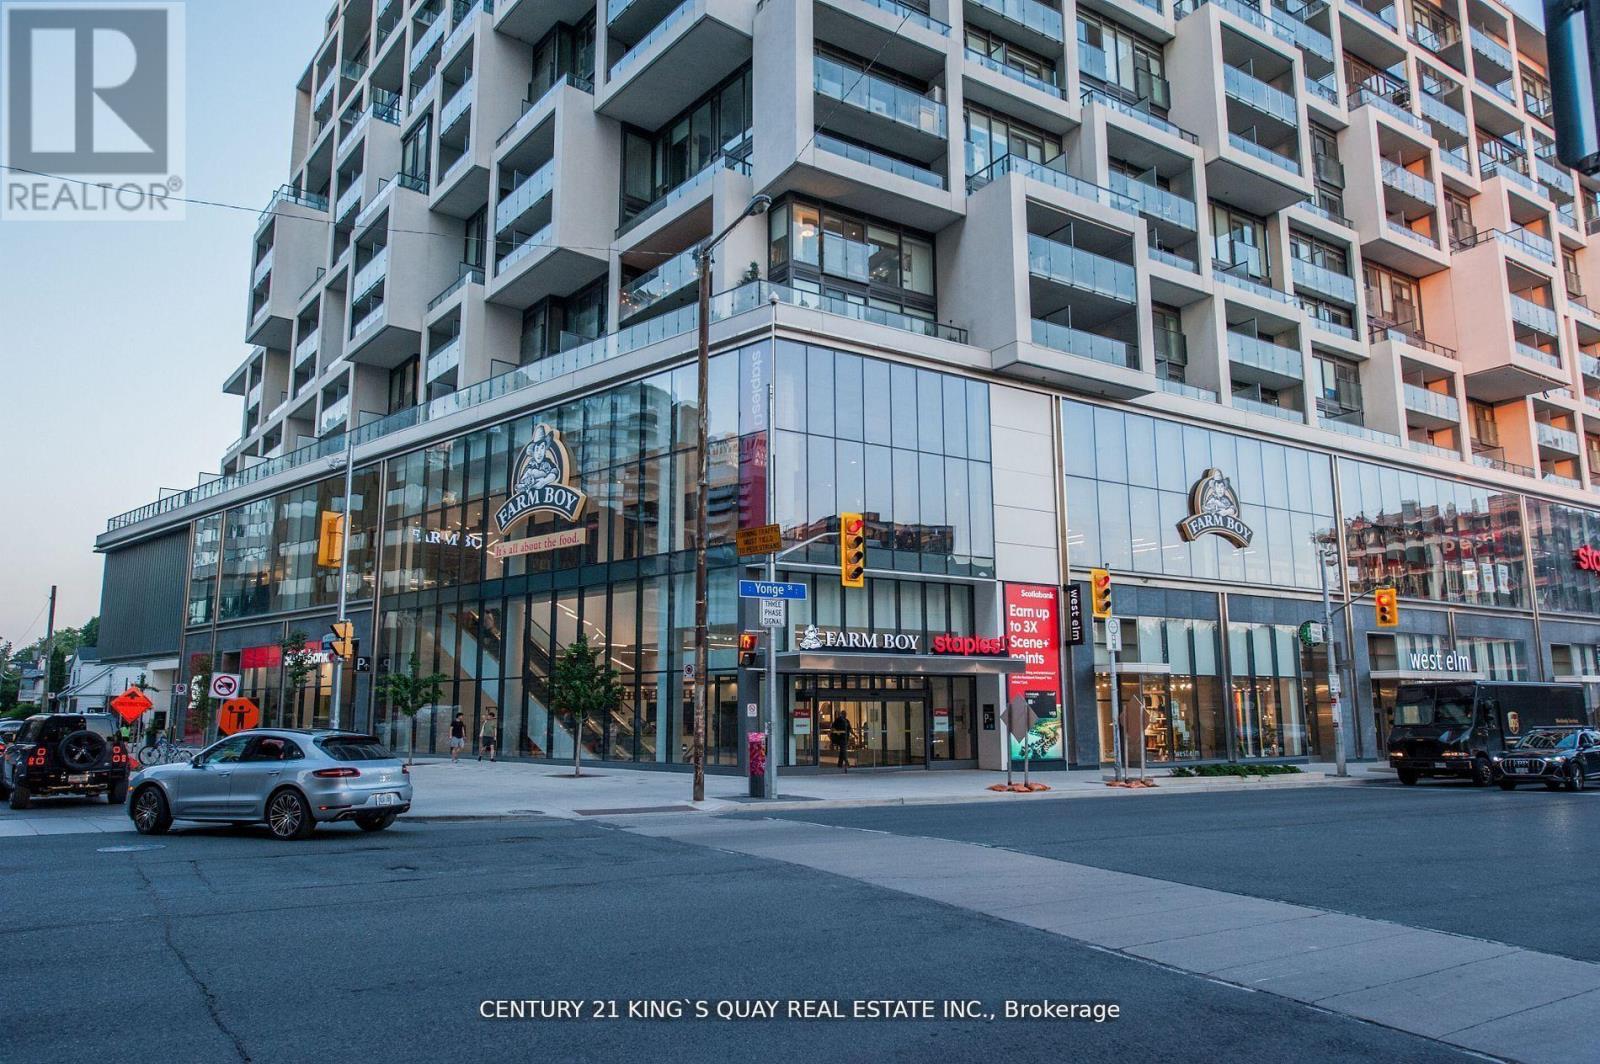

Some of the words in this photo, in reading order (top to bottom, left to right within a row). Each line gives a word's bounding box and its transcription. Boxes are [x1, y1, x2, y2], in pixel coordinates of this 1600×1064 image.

[498, 489, 540, 527] FARM
[544, 487, 578, 511] BOY
[1190, 514, 1224, 534] FARM
[1227, 517, 1252, 540] BOY
[509, 544, 518, 555] all
[521, 541, 541, 552] about
[544, 538, 557, 547] the
[559, 532, 580, 546] food.
[754, 583, 785, 597] Yonge
[1021, 589, 1054, 599] Scotiabank
[1009, 604, 1034, 617] Earn
[1036, 609, 1050, 620] up
[1070, 589, 1080, 617] west
[764, 617, 782, 625] SIGNAL
[1010, 620, 1022, 632] to
[1023, 620, 1038, 633] 3X
[1071, 619, 1081, 641] elm
[826, 631, 877, 649] FARM
[883, 633, 920, 650] BOY
[1410, 652, 1443, 671] west
[1446, 651, 1470, 671] elm
